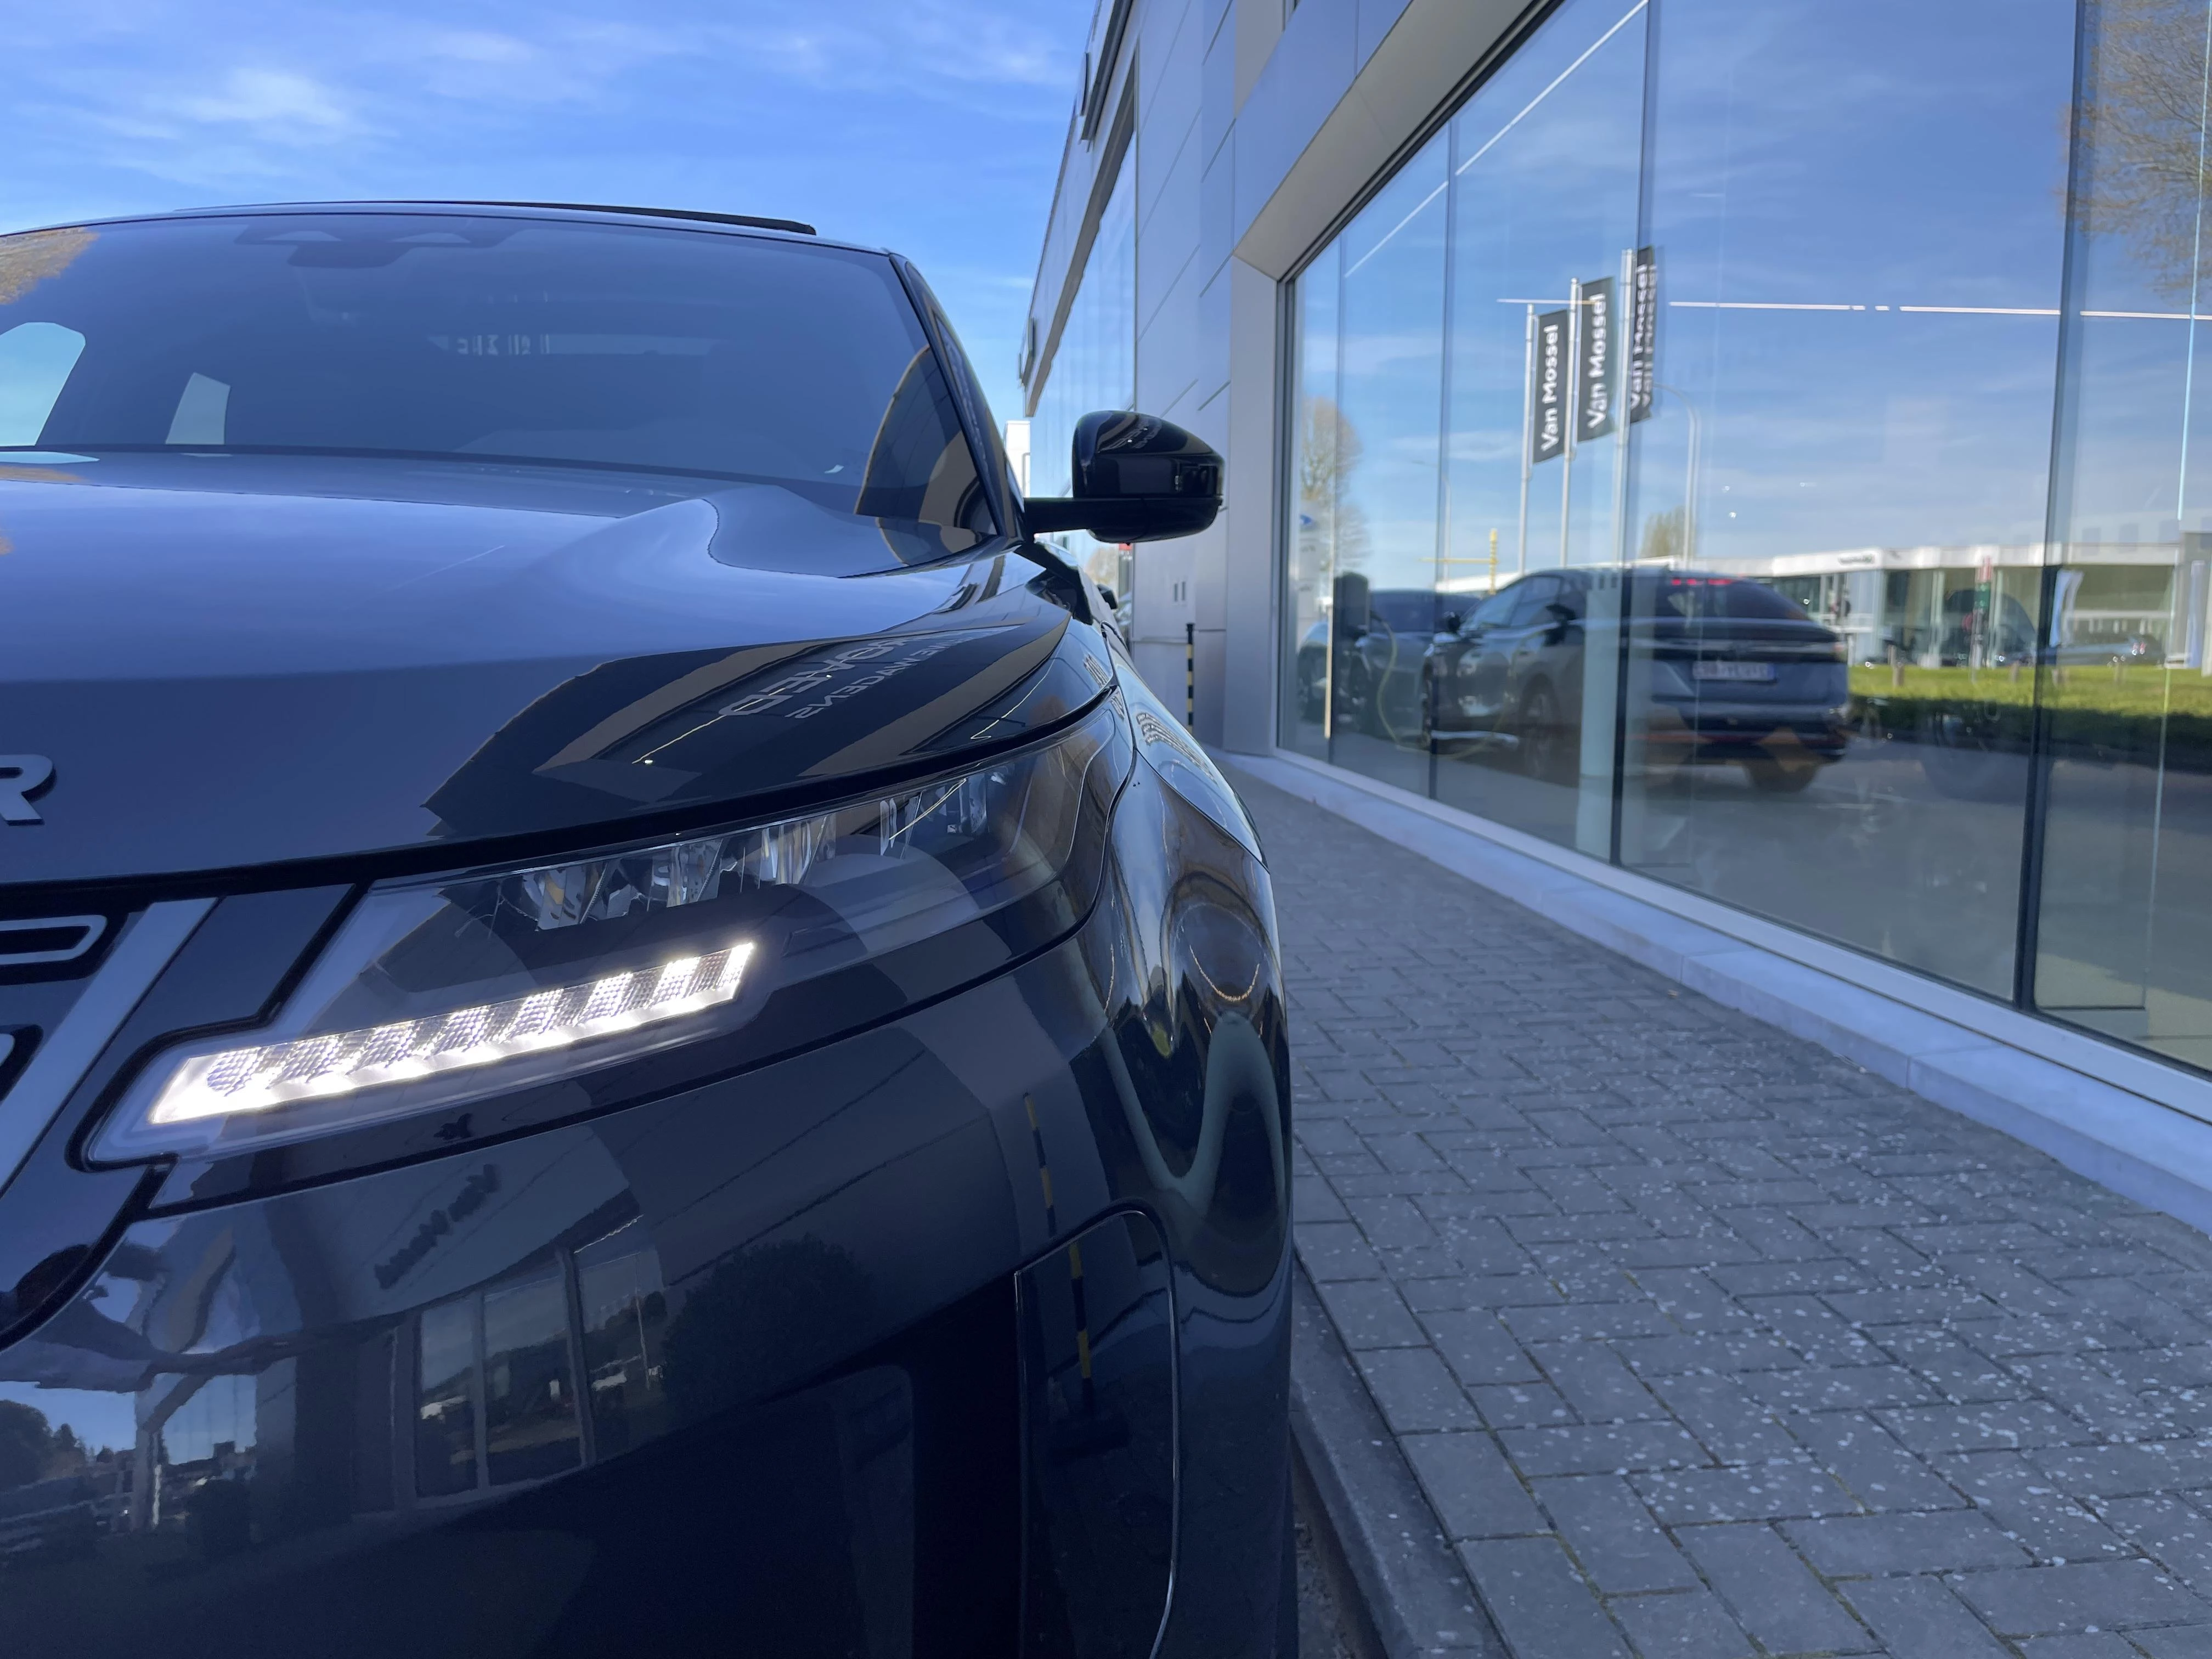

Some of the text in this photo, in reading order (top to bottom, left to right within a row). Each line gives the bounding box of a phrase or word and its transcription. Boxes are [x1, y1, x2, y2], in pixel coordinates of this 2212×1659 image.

[1541, 324, 1559, 452] Van Mossel
[1586, 293, 1608, 428] Van Mossel
